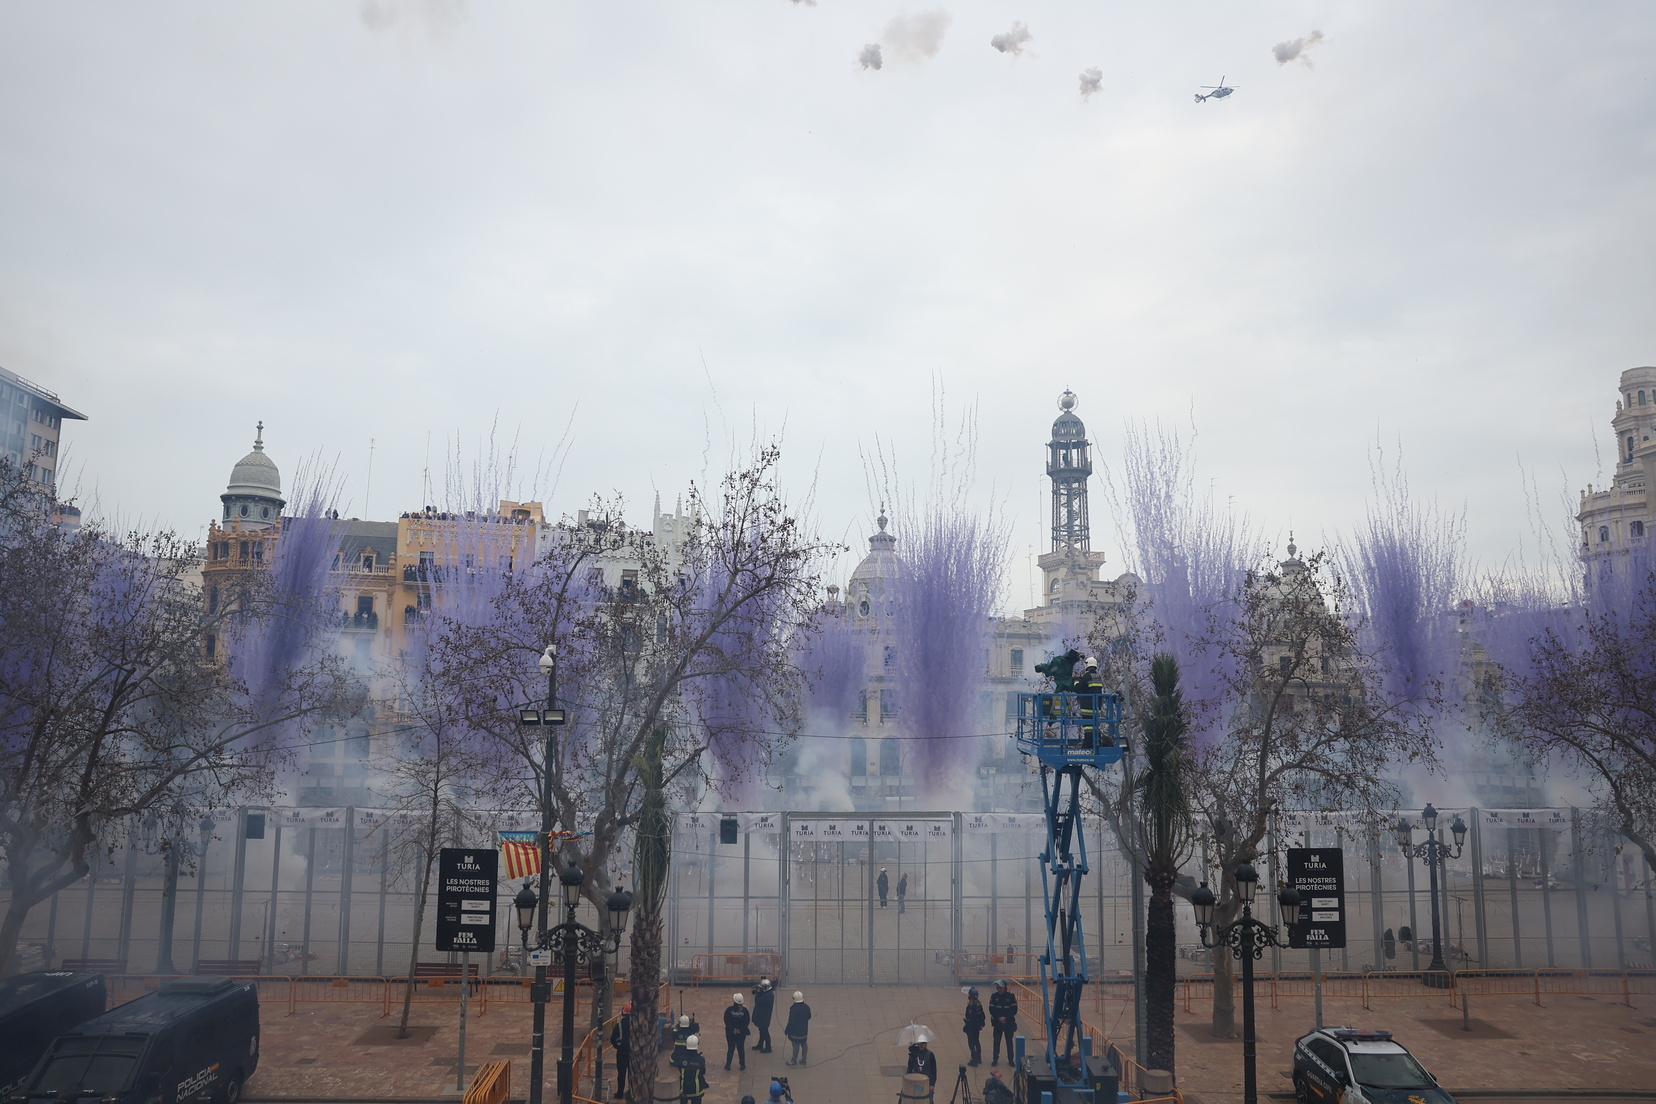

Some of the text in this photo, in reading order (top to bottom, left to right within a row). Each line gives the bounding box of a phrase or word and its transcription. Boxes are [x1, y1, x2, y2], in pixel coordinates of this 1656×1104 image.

[456, 862, 480, 870] TURIA
[176, 1072, 218, 1103] NACIONAL
[1306, 1070, 1333, 1094] GUARDIA CIVIL
